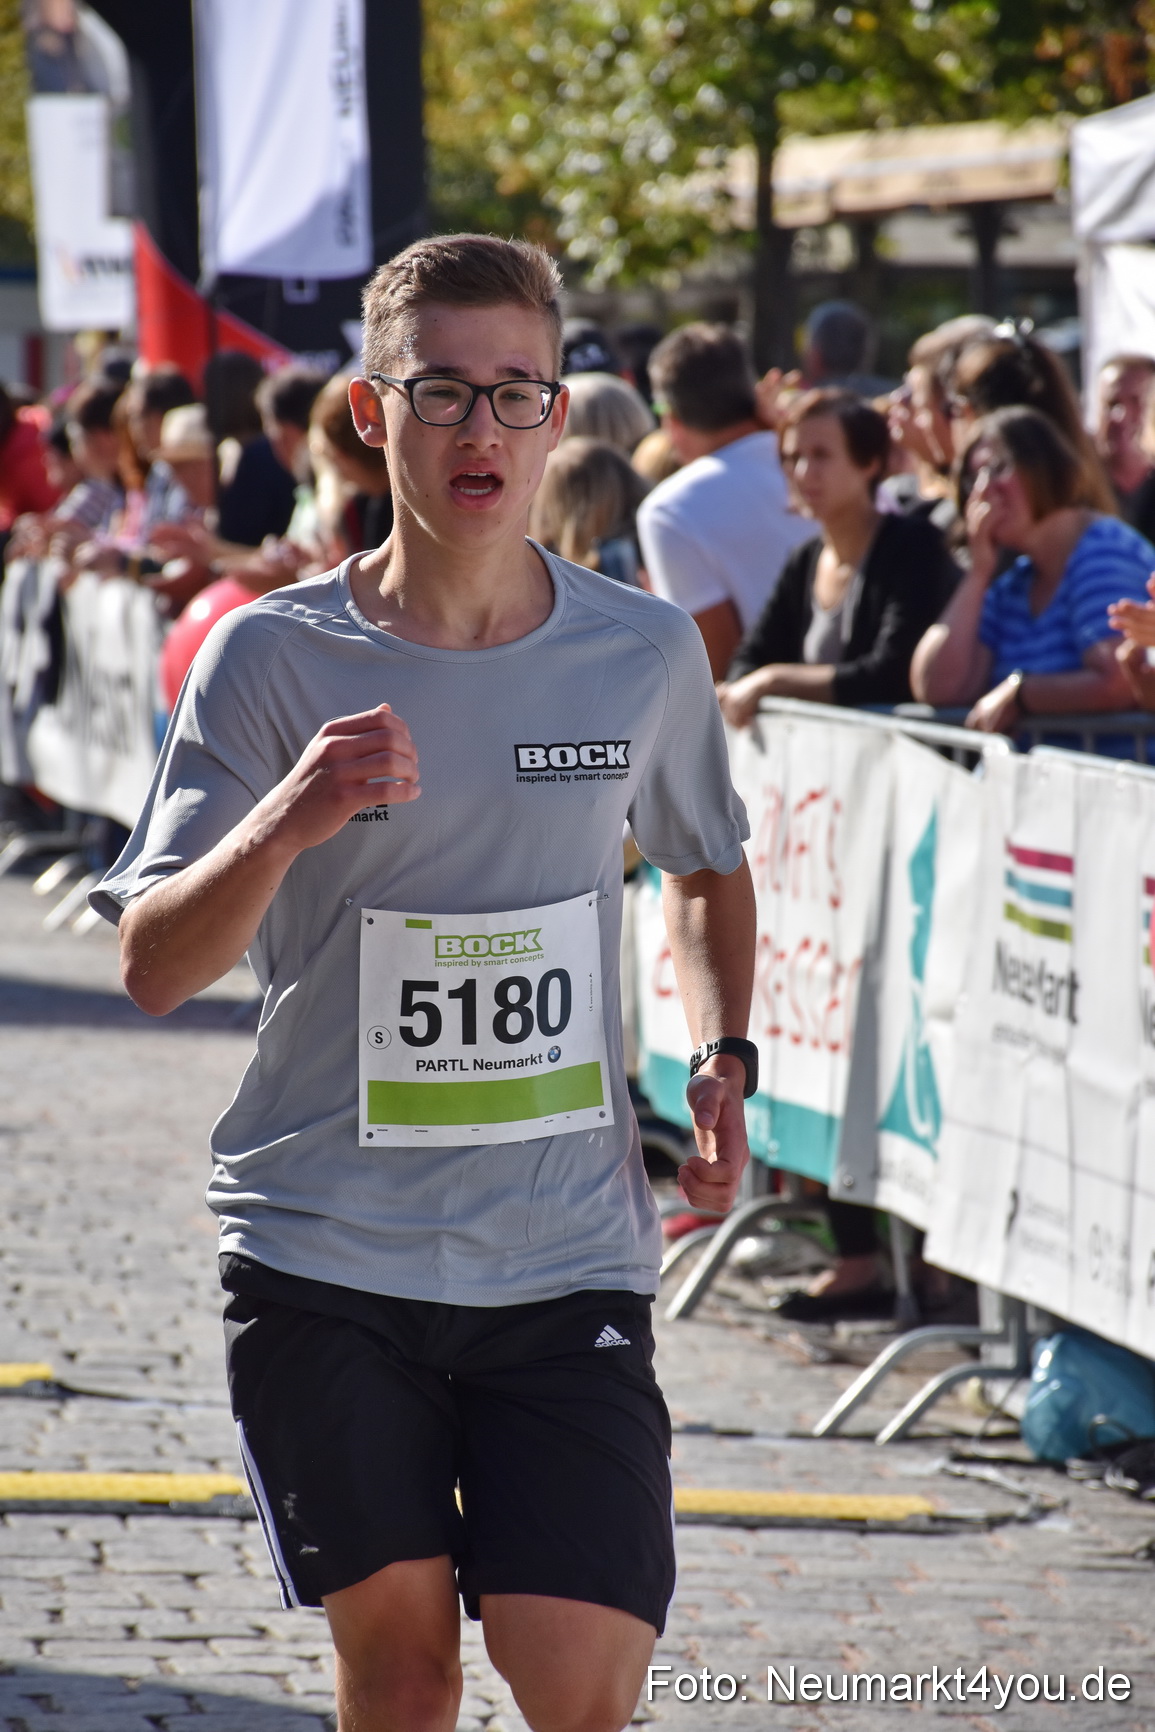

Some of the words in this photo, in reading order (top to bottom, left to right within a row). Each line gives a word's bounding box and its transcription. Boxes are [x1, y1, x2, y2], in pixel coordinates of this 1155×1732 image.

[514, 740, 631, 772] BOCK
[516, 773, 557, 784] inspired
[560, 773, 571, 783] by
[574, 772, 601, 781] smart
[349, 809, 389, 822] markt
[435, 928, 544, 958] BOCK
[434, 959, 469, 968] inspired
[471, 959, 481, 967] by
[510, 953, 545, 963] concepts
[399, 968, 572, 1048] 5180
[374, 1031, 384, 1044] S
[416, 1059, 469, 1072] PARTL
[473, 1053, 543, 1071] Neumarkt
[594, 1338, 631, 1348] adidas
